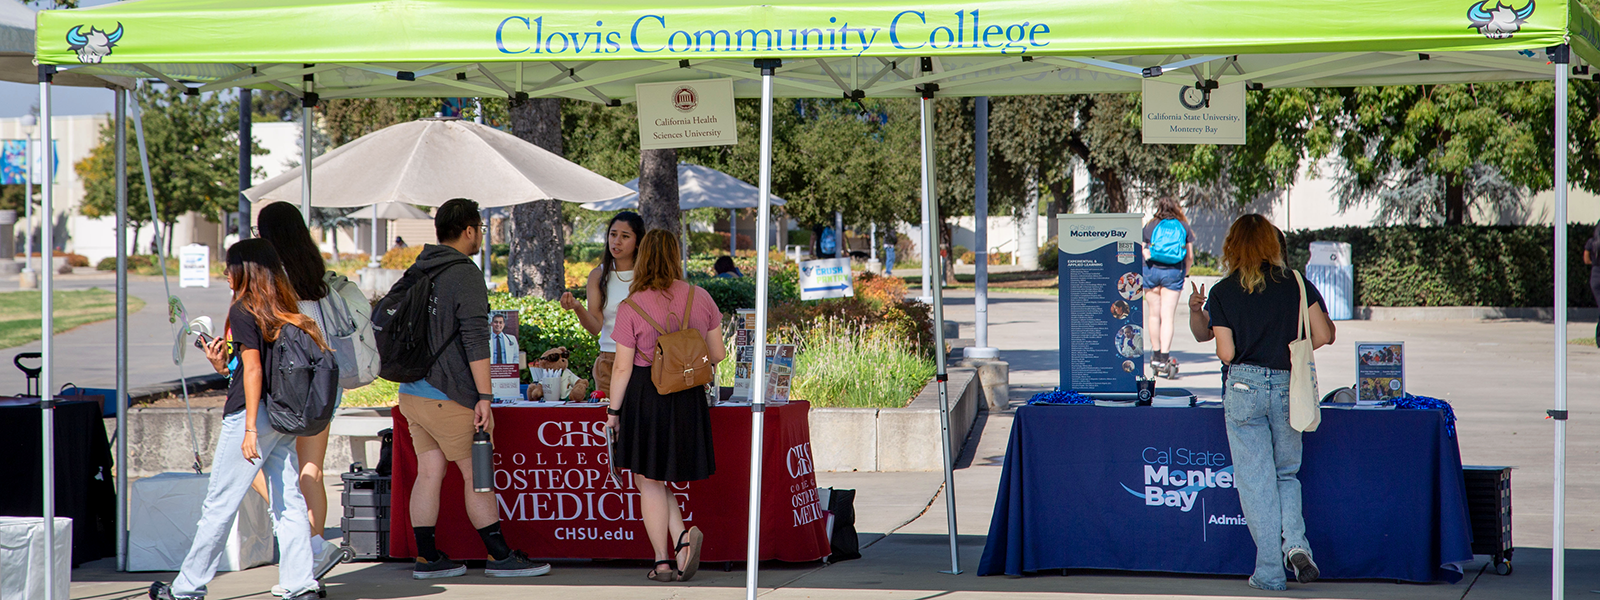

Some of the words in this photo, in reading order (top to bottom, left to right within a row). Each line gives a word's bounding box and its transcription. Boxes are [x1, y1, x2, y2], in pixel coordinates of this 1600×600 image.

[495, 15, 621, 54] Clovis
[630, 14, 881, 57] Community
[889, 8, 1051, 55] College
[654, 116, 691, 127] California
[692, 115, 718, 125] Health
[1147, 112, 1182, 121] California
[1183, 112, 1201, 121] State
[1202, 113, 1241, 123] University,
[653, 131, 683, 140] Sciences
[684, 129, 722, 138] University
[1169, 125, 1204, 134] Monterey
[1204, 125, 1218, 134] Bay
[1070, 230, 1110, 238] Monterey
[1110, 230, 1128, 238] Bay
[816, 266, 843, 276] CRUSH
[816, 274, 849, 284] PANTRY
[537, 421, 608, 447] CHS
[493, 452, 609, 466] COLLEG
[1142, 446, 1172, 465] Cal
[1175, 447, 1226, 467] State
[1145, 486, 1199, 512] Bay
[496, 492, 693, 521] MEDICIE
[554, 527, 634, 541] CHSU.edu
